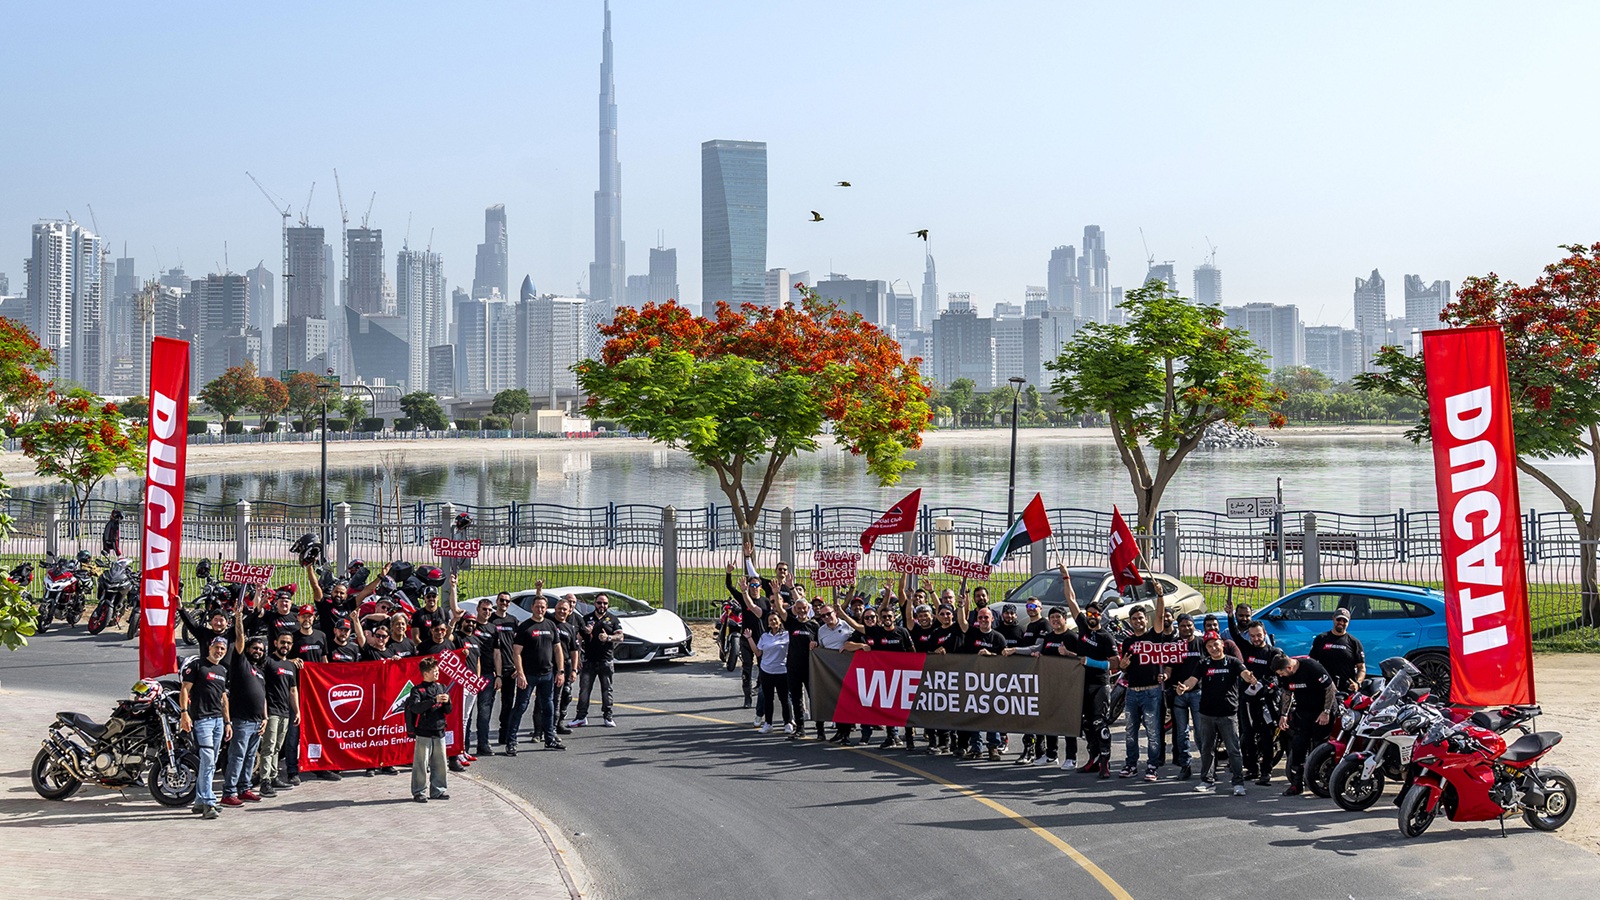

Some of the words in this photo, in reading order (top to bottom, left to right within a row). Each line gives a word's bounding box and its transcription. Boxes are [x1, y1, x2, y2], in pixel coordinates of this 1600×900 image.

[145, 390, 177, 627] DUCATI
[1247, 503, 1254, 513] 2
[432, 539, 481, 550] #Ducati
[435, 548, 477, 557] Emirates
[815, 551, 861, 561] #WeAre
[818, 560, 857, 570] Ducati
[889, 553, 935, 568] #WeRide
[943, 556, 992, 574] #Ducati
[223, 561, 275, 577] #Ducati
[811, 569, 857, 580] #Ducati
[889, 562, 929, 576] AsOne
[945, 565, 989, 581] Emirates
[224, 572, 268, 584] Emirates
[815, 577, 855, 588] Emirates
[1204, 573, 1258, 588] #Ducati
[1133, 640, 1188, 653] #Ducati
[1140, 652, 1183, 665] Dubai
[440, 650, 489, 690] #Ducati
[438, 660, 479, 695] Emirates
[924, 671, 959, 690] ARE
[965, 672, 1040, 694] DUCATI
[332, 690, 360, 698] DUCATI
[856, 668, 923, 709] WE
[915, 691, 959, 712] RIDE
[964, 694, 990, 713] AS
[993, 695, 1040, 716] ONE
[327, 727, 364, 739] Ducati
[367, 723, 407, 737] Official
[339, 741, 367, 750] United
[369, 738, 389, 747] Arab
